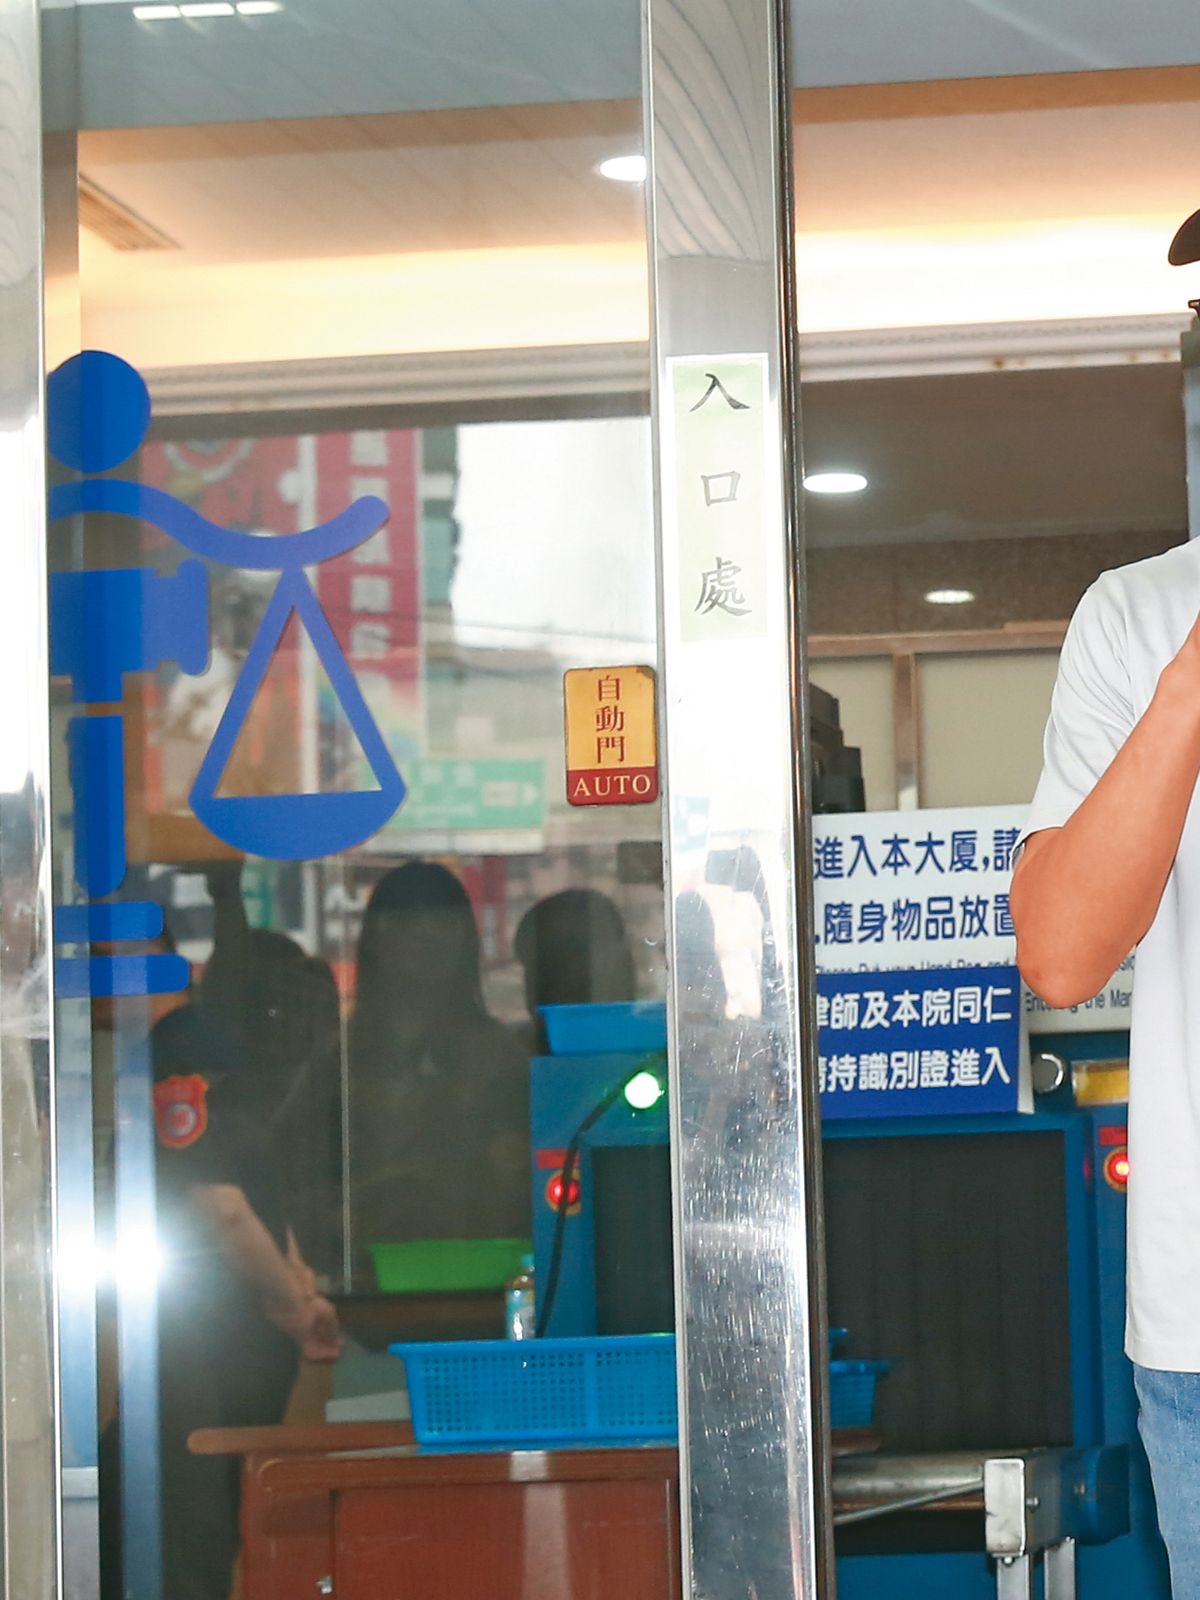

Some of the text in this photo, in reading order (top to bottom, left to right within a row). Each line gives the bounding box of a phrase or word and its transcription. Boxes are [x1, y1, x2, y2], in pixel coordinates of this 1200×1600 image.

[689, 373, 753, 617] 入口處
[595, 675, 625, 764] 自動門
[573, 774, 652, 798] AUTO
